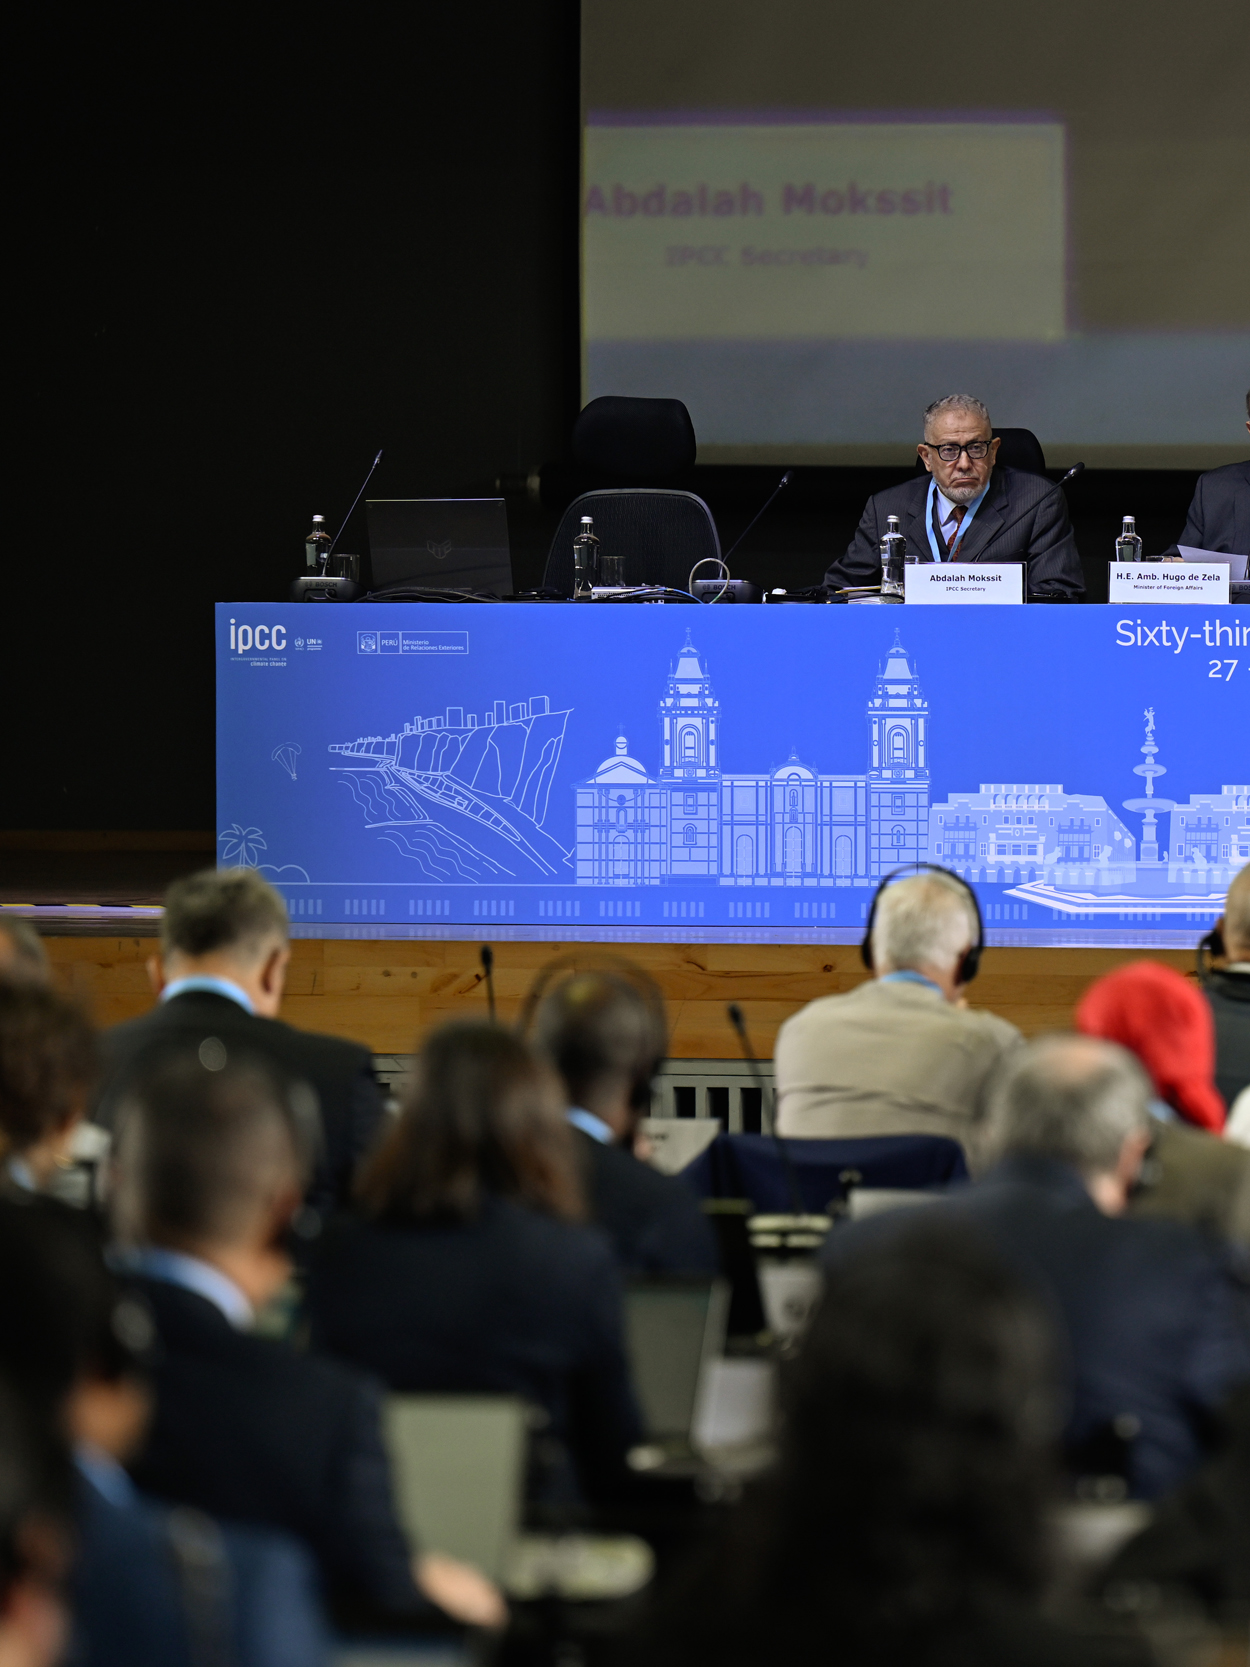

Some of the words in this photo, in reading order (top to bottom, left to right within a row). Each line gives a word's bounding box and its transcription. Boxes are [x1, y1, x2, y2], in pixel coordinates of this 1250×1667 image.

[583, 182, 764, 218] Abdalah
[783, 180, 954, 216] Mokssit
[930, 574, 966, 582] Abdalah
[969, 574, 1002, 582] Mokssit
[1116, 572, 1134, 580] H.E.
[1137, 573, 1160, 581] Amb.
[1162, 573, 1186, 583] Hugo
[1188, 573, 1200, 581] de
[230, 618, 287, 655] ipcc
[381, 638, 399, 647] PERÚ
[1208, 659, 1239, 682] 27
